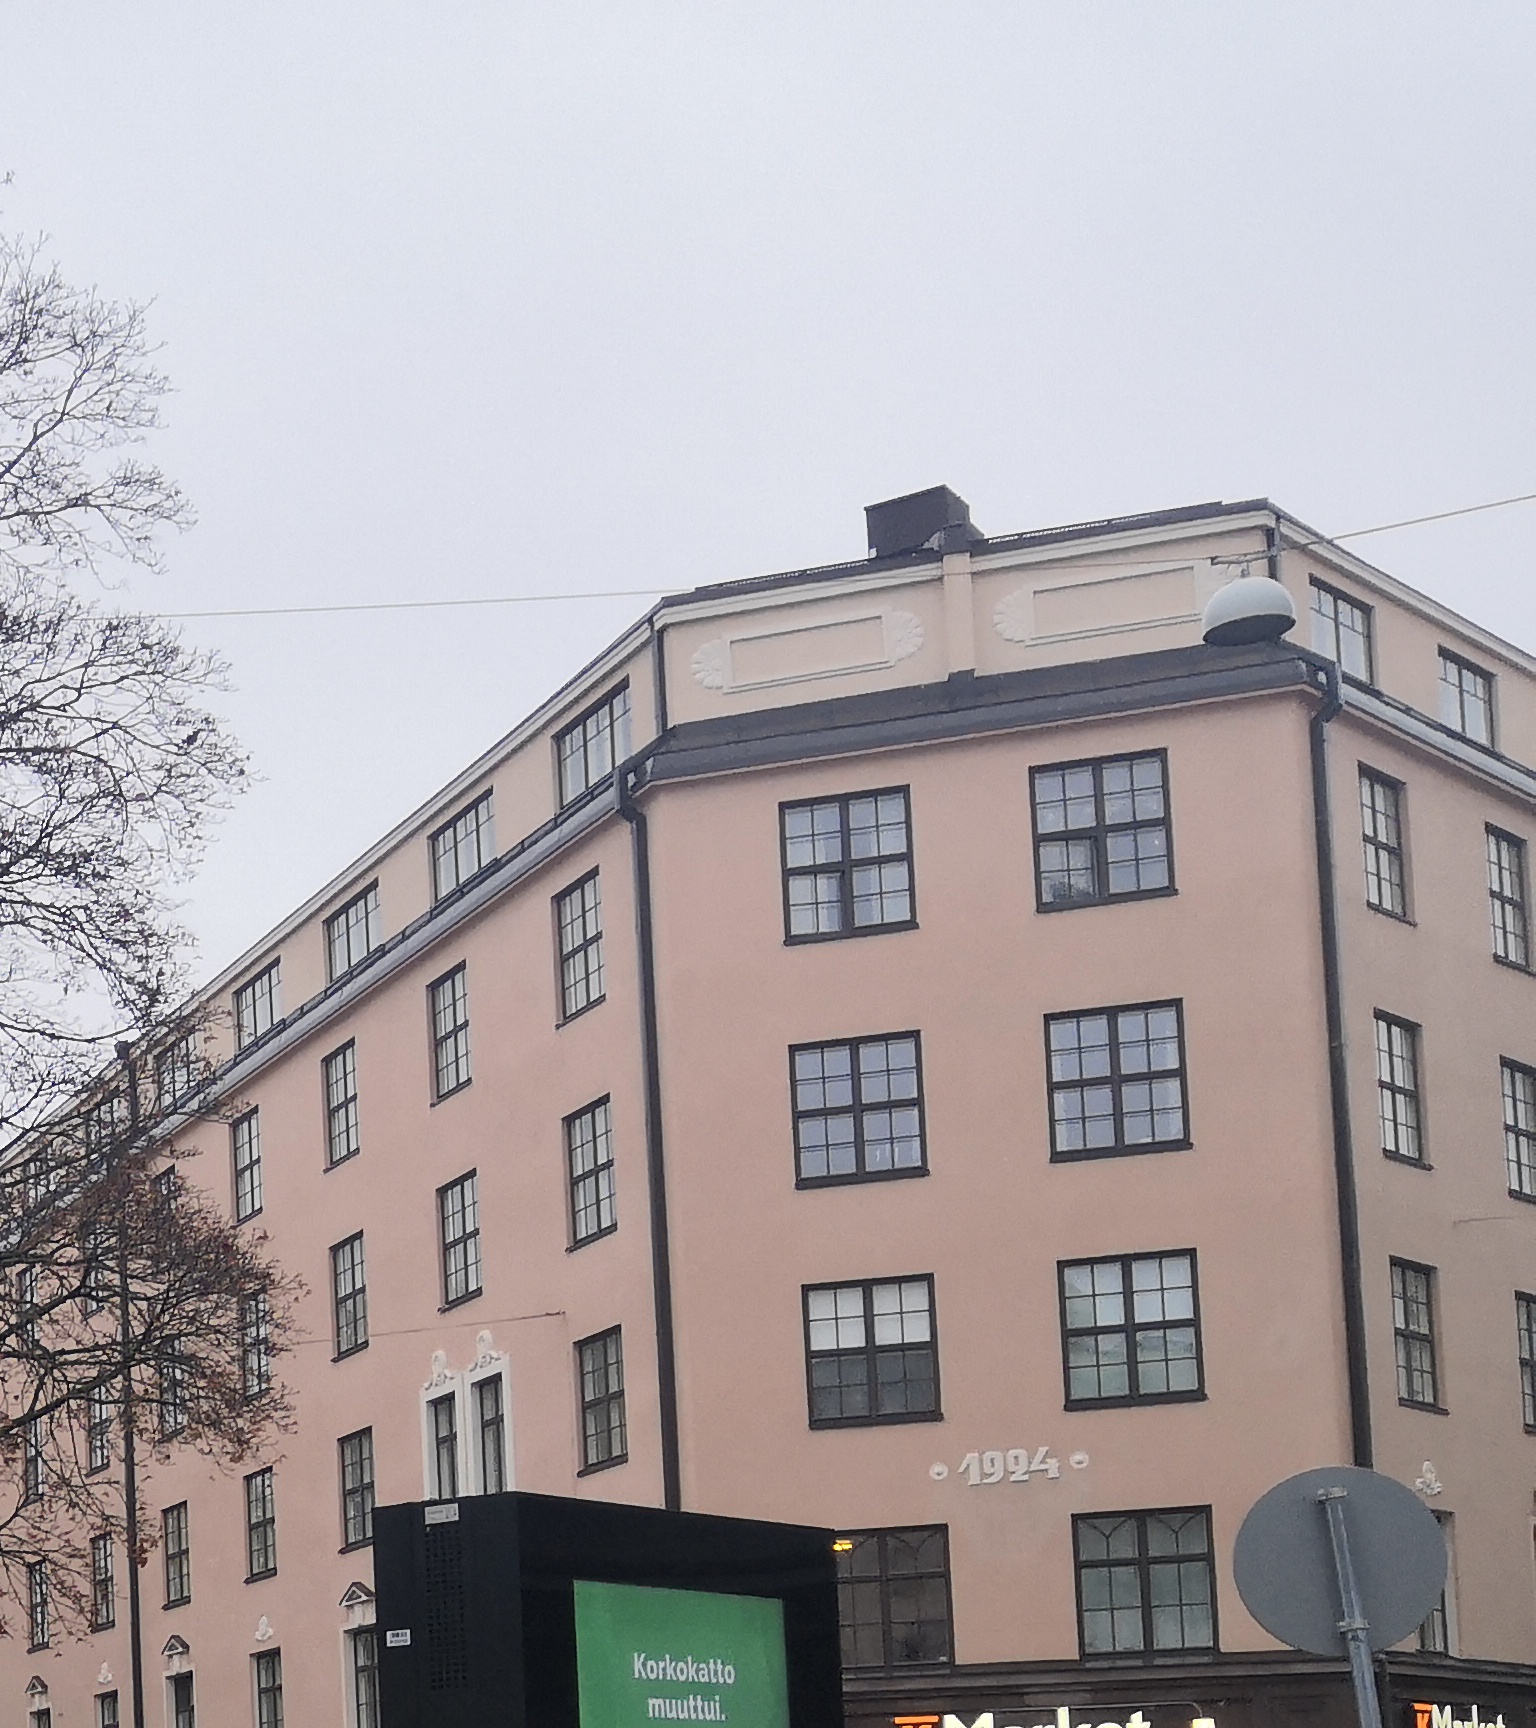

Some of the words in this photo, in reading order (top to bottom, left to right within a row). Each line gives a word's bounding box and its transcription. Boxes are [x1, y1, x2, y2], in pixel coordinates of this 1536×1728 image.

[957, 1446, 1061, 1486] 1924
[633, 1652, 736, 1685] Korkokatto
[648, 1694, 727, 1722] muuttui.
